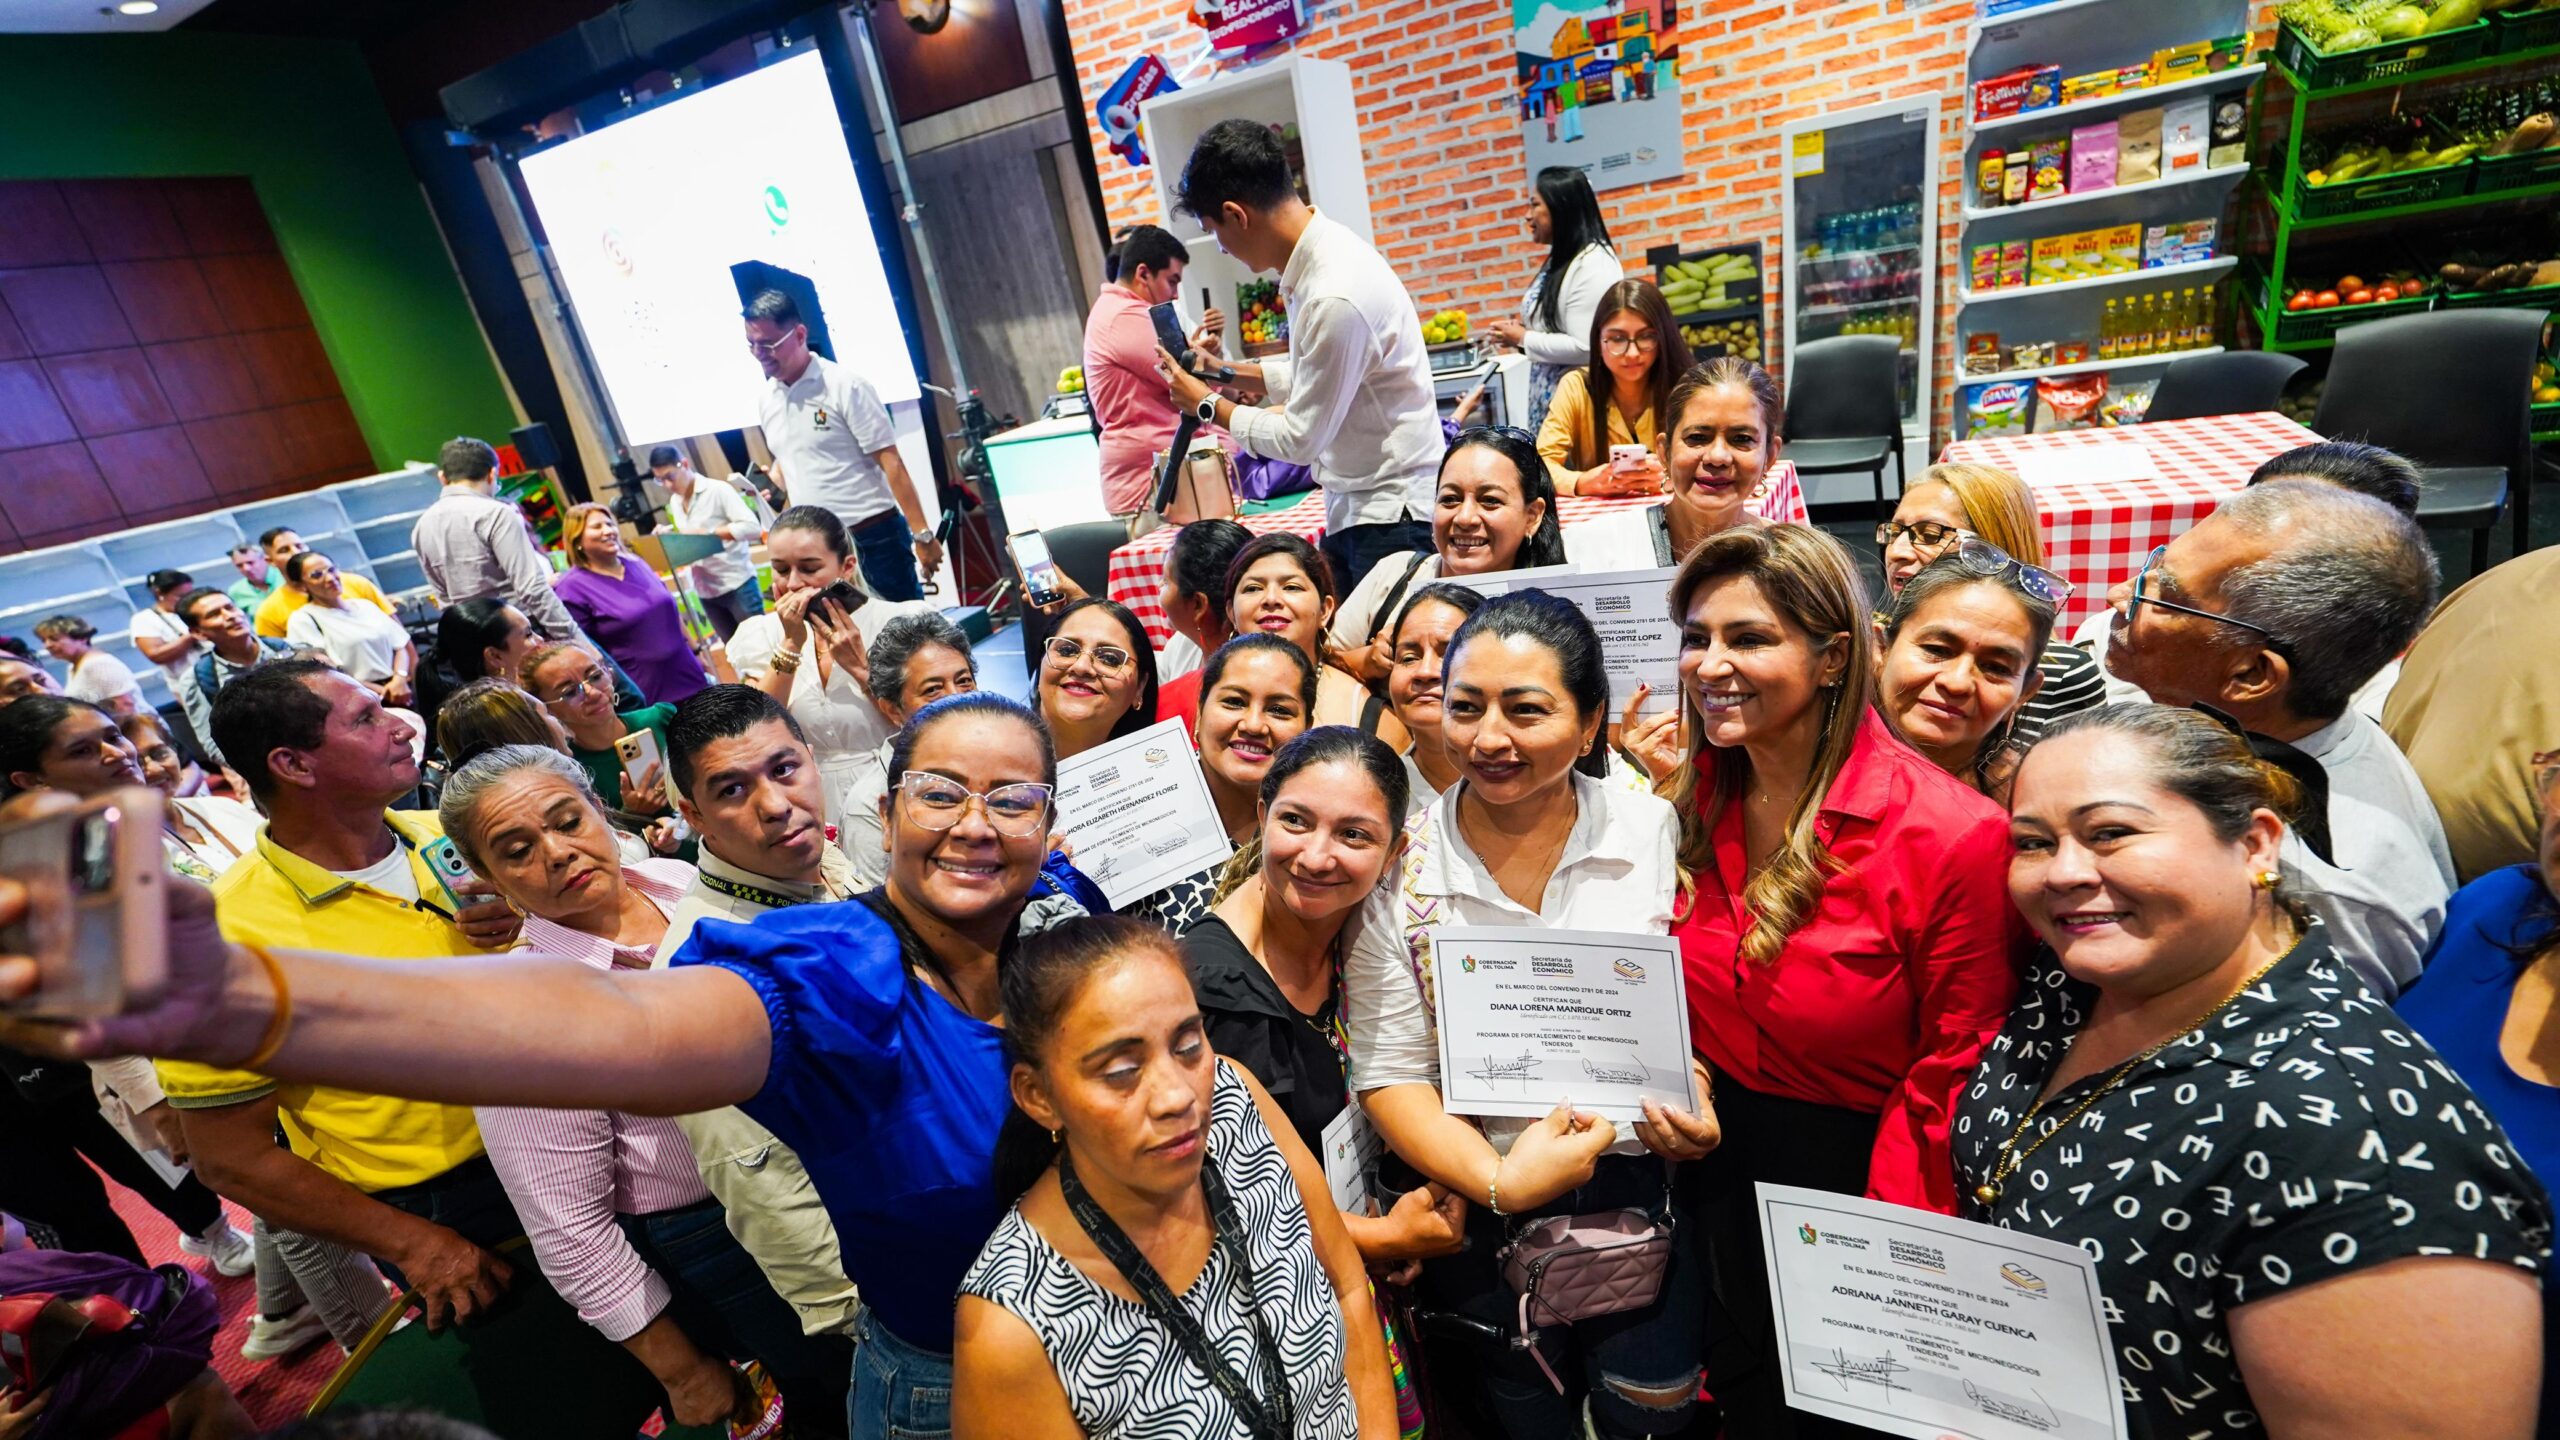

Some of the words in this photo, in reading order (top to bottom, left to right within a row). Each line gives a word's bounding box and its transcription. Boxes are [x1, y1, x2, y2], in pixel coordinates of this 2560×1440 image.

[1125, 64, 1159, 113] Gracias
[1983, 386, 2017, 406] DIANA
[1086, 809, 1118, 827] ELIZABETH
[1118, 793, 1155, 813] HERNANDEZ
[1155, 783, 1178, 797] FLOREZ
[1532, 967, 1574, 975] ECONÓMICO
[1490, 1003, 1518, 1011] DIANA
[1520, 1004, 1555, 1012] LORENA
[1556, 1005, 1604, 1015] MANRIQUE
[1605, 1008, 1632, 1018] ORTIZ
[1587, 1035, 1639, 1045] MICRONEGOCIOS
[1820, 1231, 1870, 1245] GOBERNACIÓN
[1826, 1238, 1839, 1246] DEL
[1840, 1241, 1866, 1250] TOLIMA
[1888, 1238, 1929, 1252] Secretaría
[1932, 1248, 1943, 1256] de
[1889, 1245, 1944, 1262] DESARROLLO
[1890, 1252, 1946, 1270] ECONÓMICO
[1843, 1264, 1853, 1272] EN
[1855, 1266, 1865, 1274] EL
[1866, 1269, 1895, 1280] MARCO
[1896, 1274, 1911, 1284] DEL
[1913, 1278, 1955, 1294] CONVENIO
[1957, 1289, 1974, 1299] 2781
[1976, 1294, 1988, 1303] DE
[1990, 1298, 2010, 1308] 2024
[1893, 1288, 1940, 1305] CERTIFICAN
[1941, 1300, 1959, 1310] QUE
[1832, 1285, 1883, 1303] ADRIANA
[1885, 1296, 1937, 1316] JANNETH
[1940, 1309, 1982, 1326] GARAY
[1984, 1320, 2037, 1342] CUENCA
[1822, 1317, 1865, 1332] PROGRAMA
[1866, 1326, 1877, 1335] DE
[1879, 1329, 1954, 1353] FORTALECIMIENTO
[1954, 1347, 1966, 1357] DE
[1967, 1351, 2041, 1377] MICRONEGOCIOS
[1906, 1344, 1949, 1361] TENDEROS
